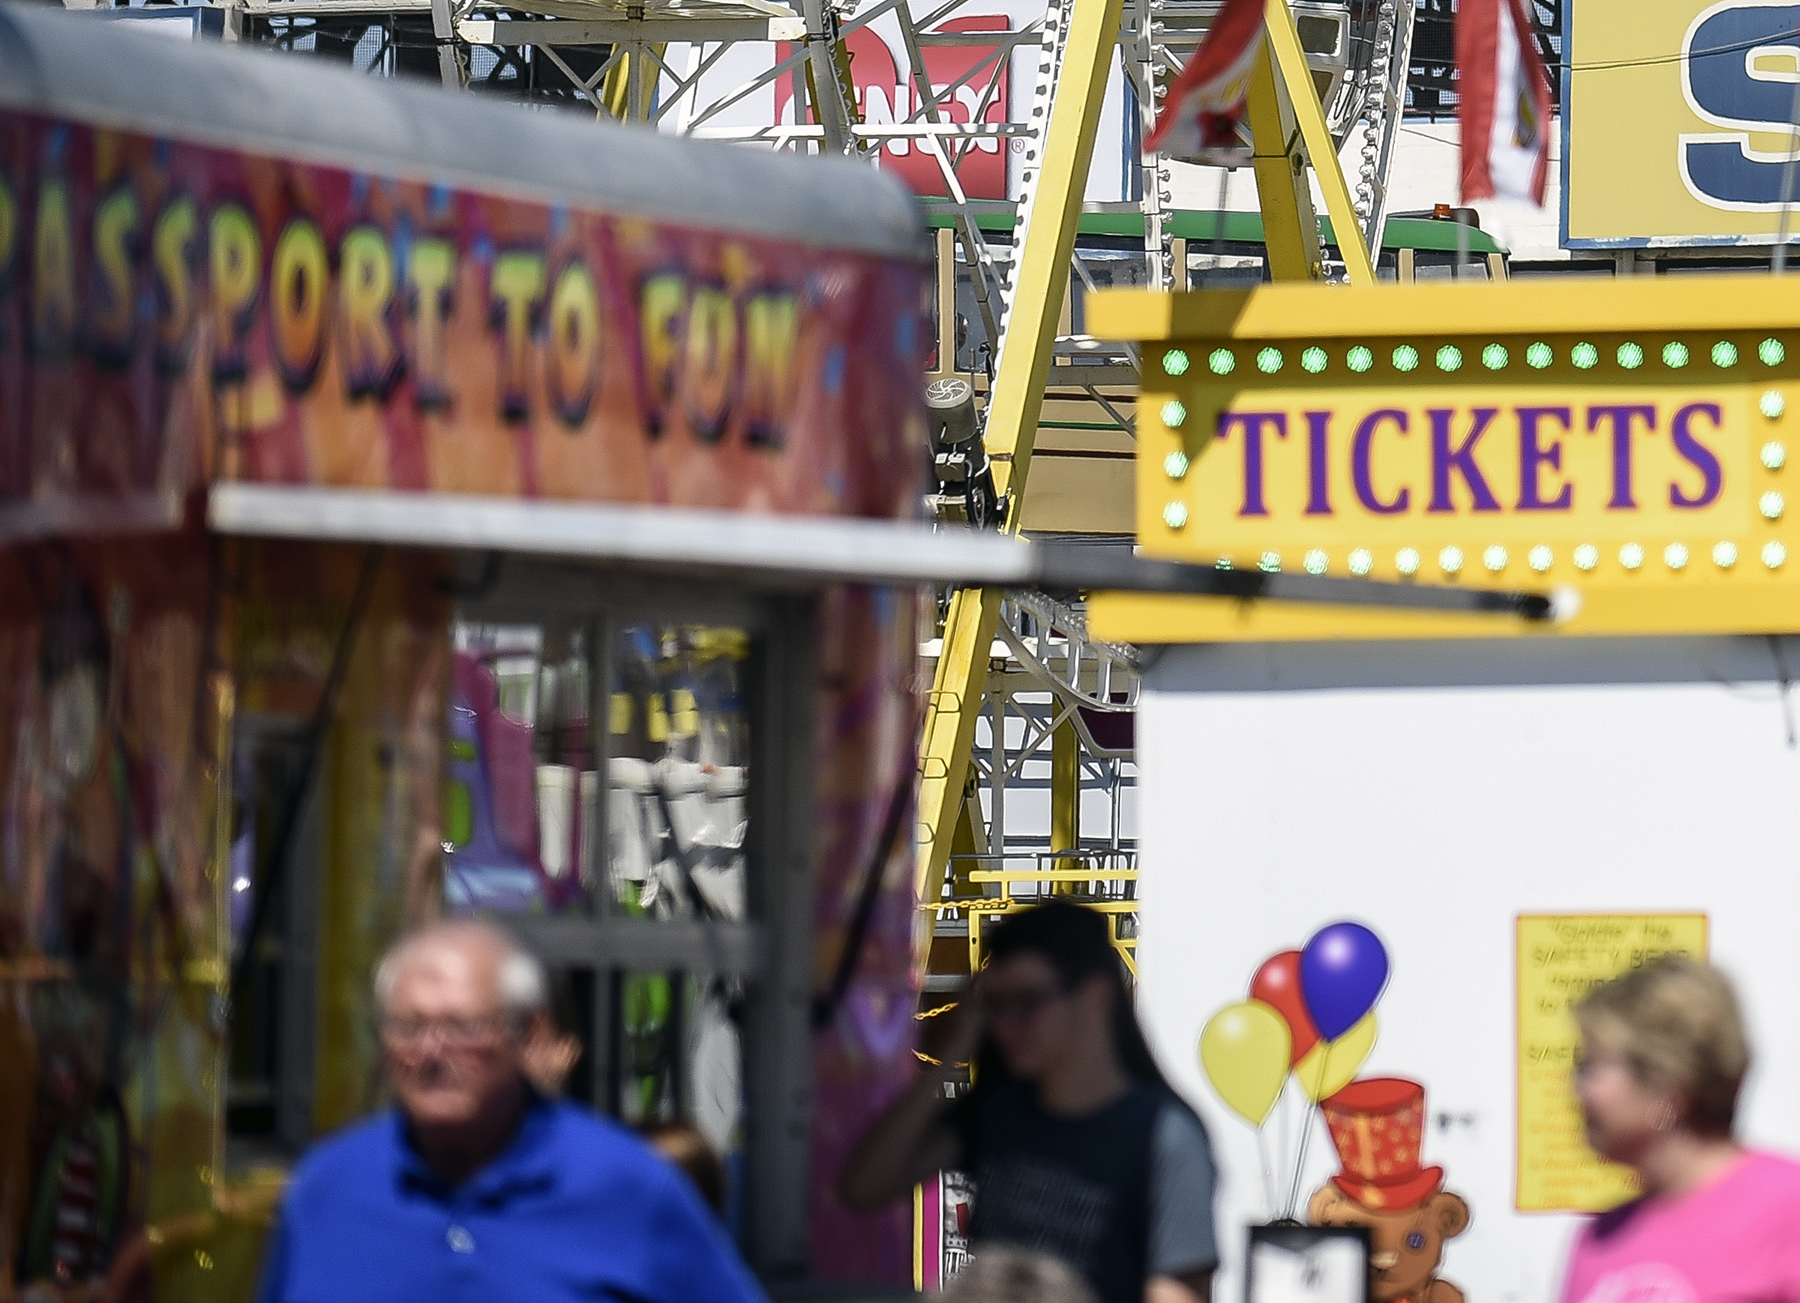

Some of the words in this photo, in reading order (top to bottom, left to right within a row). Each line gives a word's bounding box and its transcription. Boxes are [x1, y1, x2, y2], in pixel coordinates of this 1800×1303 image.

[487, 247, 600, 429] TO
[640, 267, 799, 450] FUN
[1216, 401, 1724, 516] TICKETS
